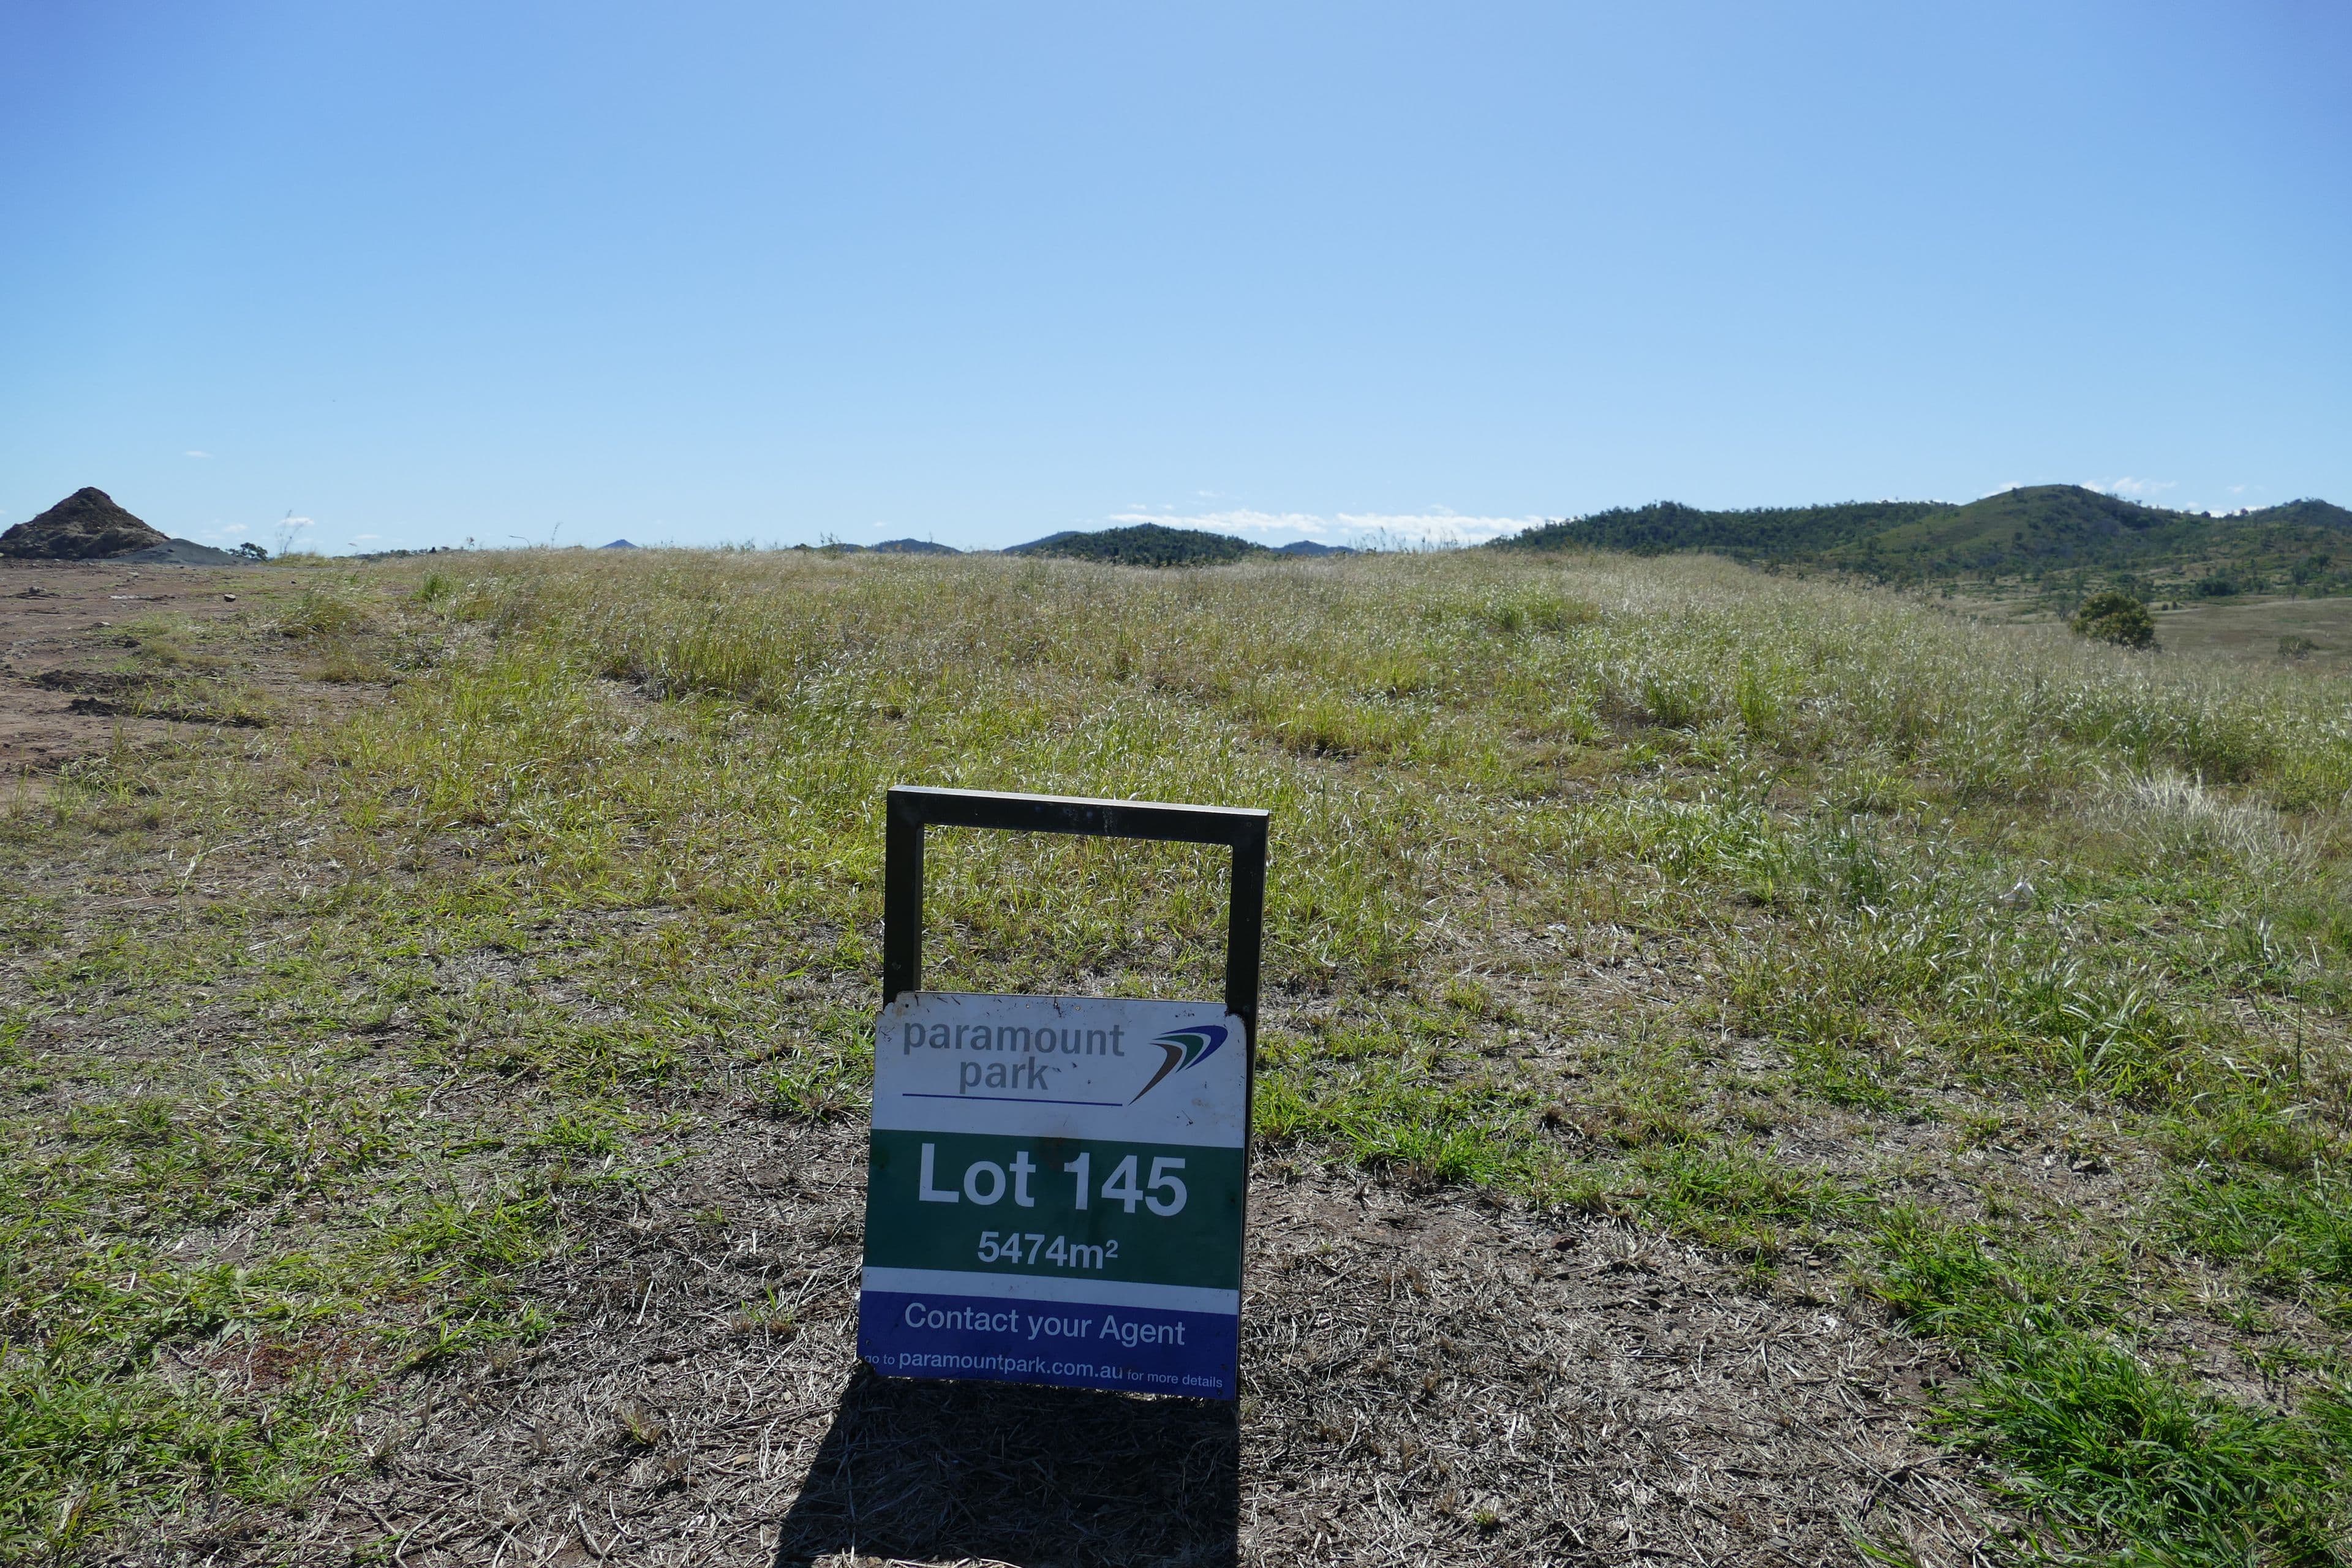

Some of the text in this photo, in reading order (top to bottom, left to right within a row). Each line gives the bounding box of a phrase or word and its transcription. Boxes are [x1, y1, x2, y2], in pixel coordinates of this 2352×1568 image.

[903, 1022, 1125, 1057] paramount
[959, 1056, 1049, 1095] park
[919, 1143, 1187, 1216] Lot 145
[905, 1302, 1186, 1348] Contact your Agent
[883, 1354, 895, 1365] to
[899, 1352, 1123, 1379] paramountpark.com.au
[1127, 1369, 1144, 1381] for
[1148, 1373, 1178, 1384] more
[1182, 1374, 1223, 1388] details
